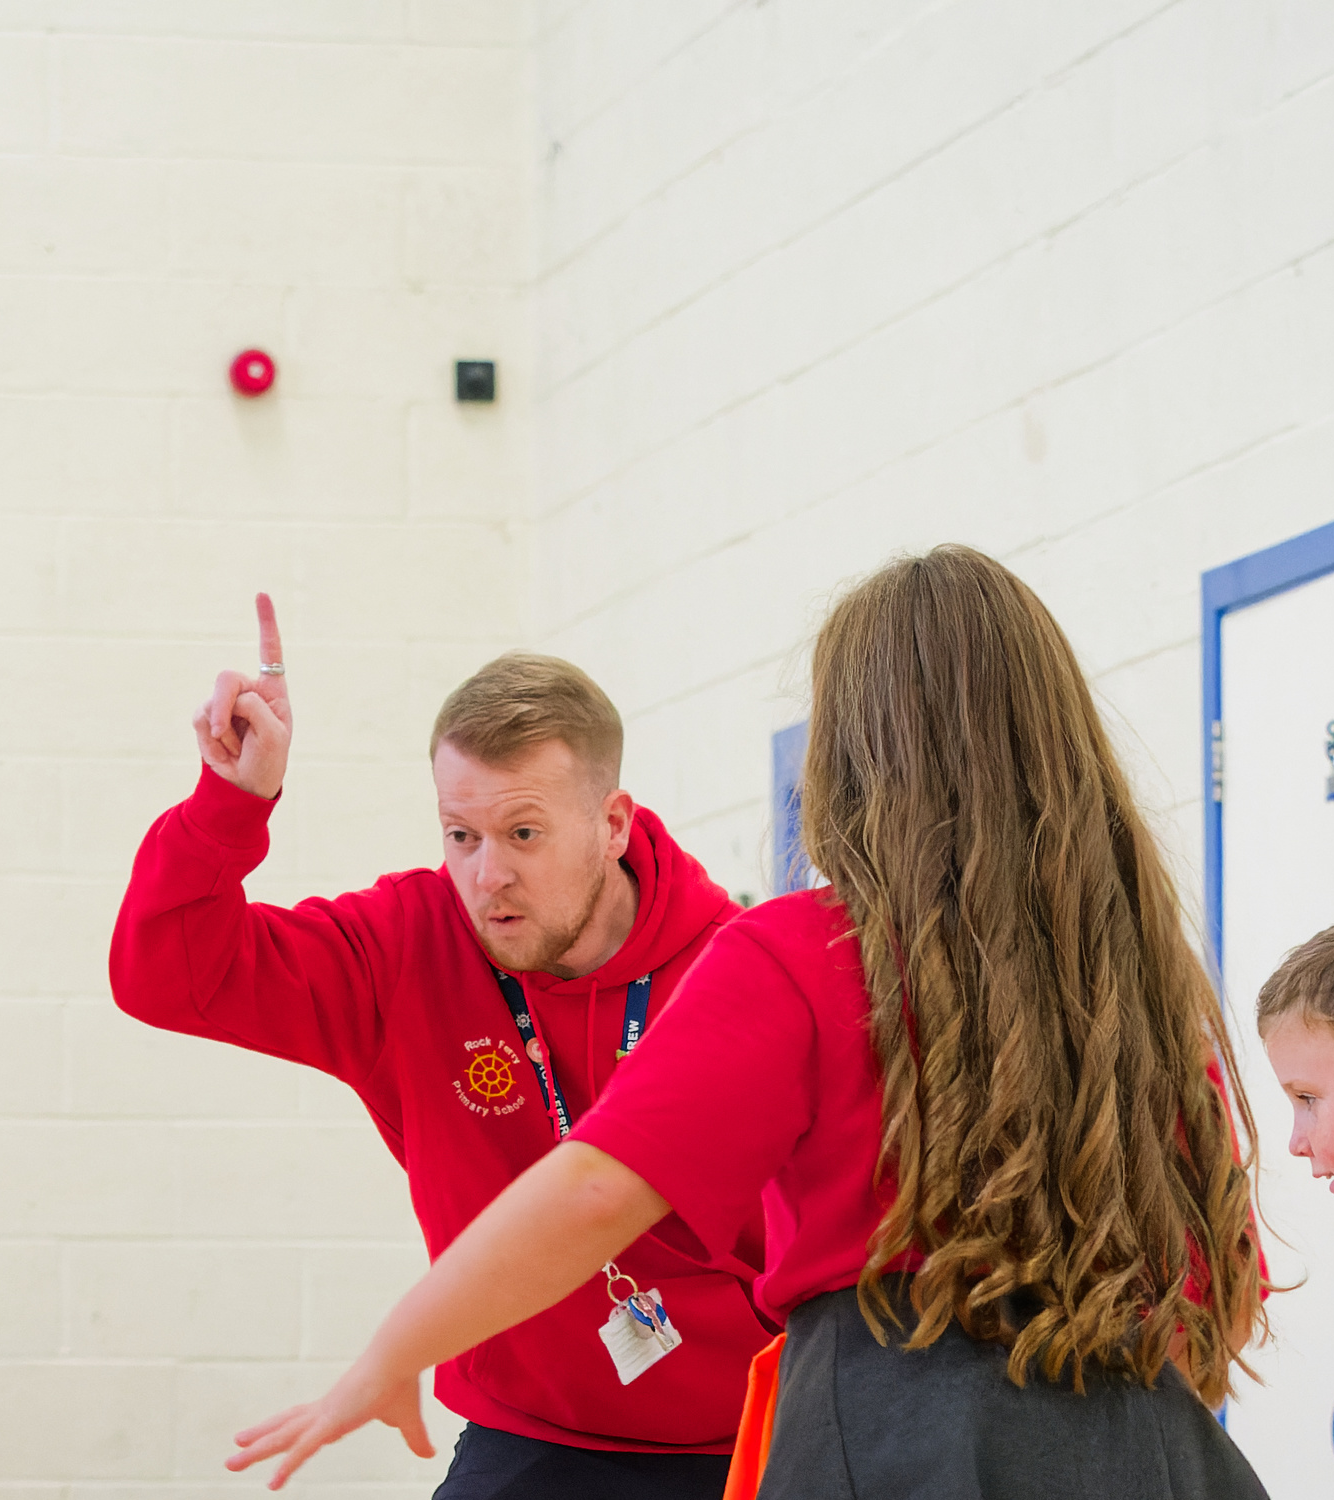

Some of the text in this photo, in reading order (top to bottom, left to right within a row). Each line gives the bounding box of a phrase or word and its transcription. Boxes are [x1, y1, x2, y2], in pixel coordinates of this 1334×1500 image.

[464, 1036, 492, 1052] Rock
[626, 1020, 639, 1055] REW
[452, 1080, 525, 1117] Primary School
[555, 1099, 570, 1136] FERR
